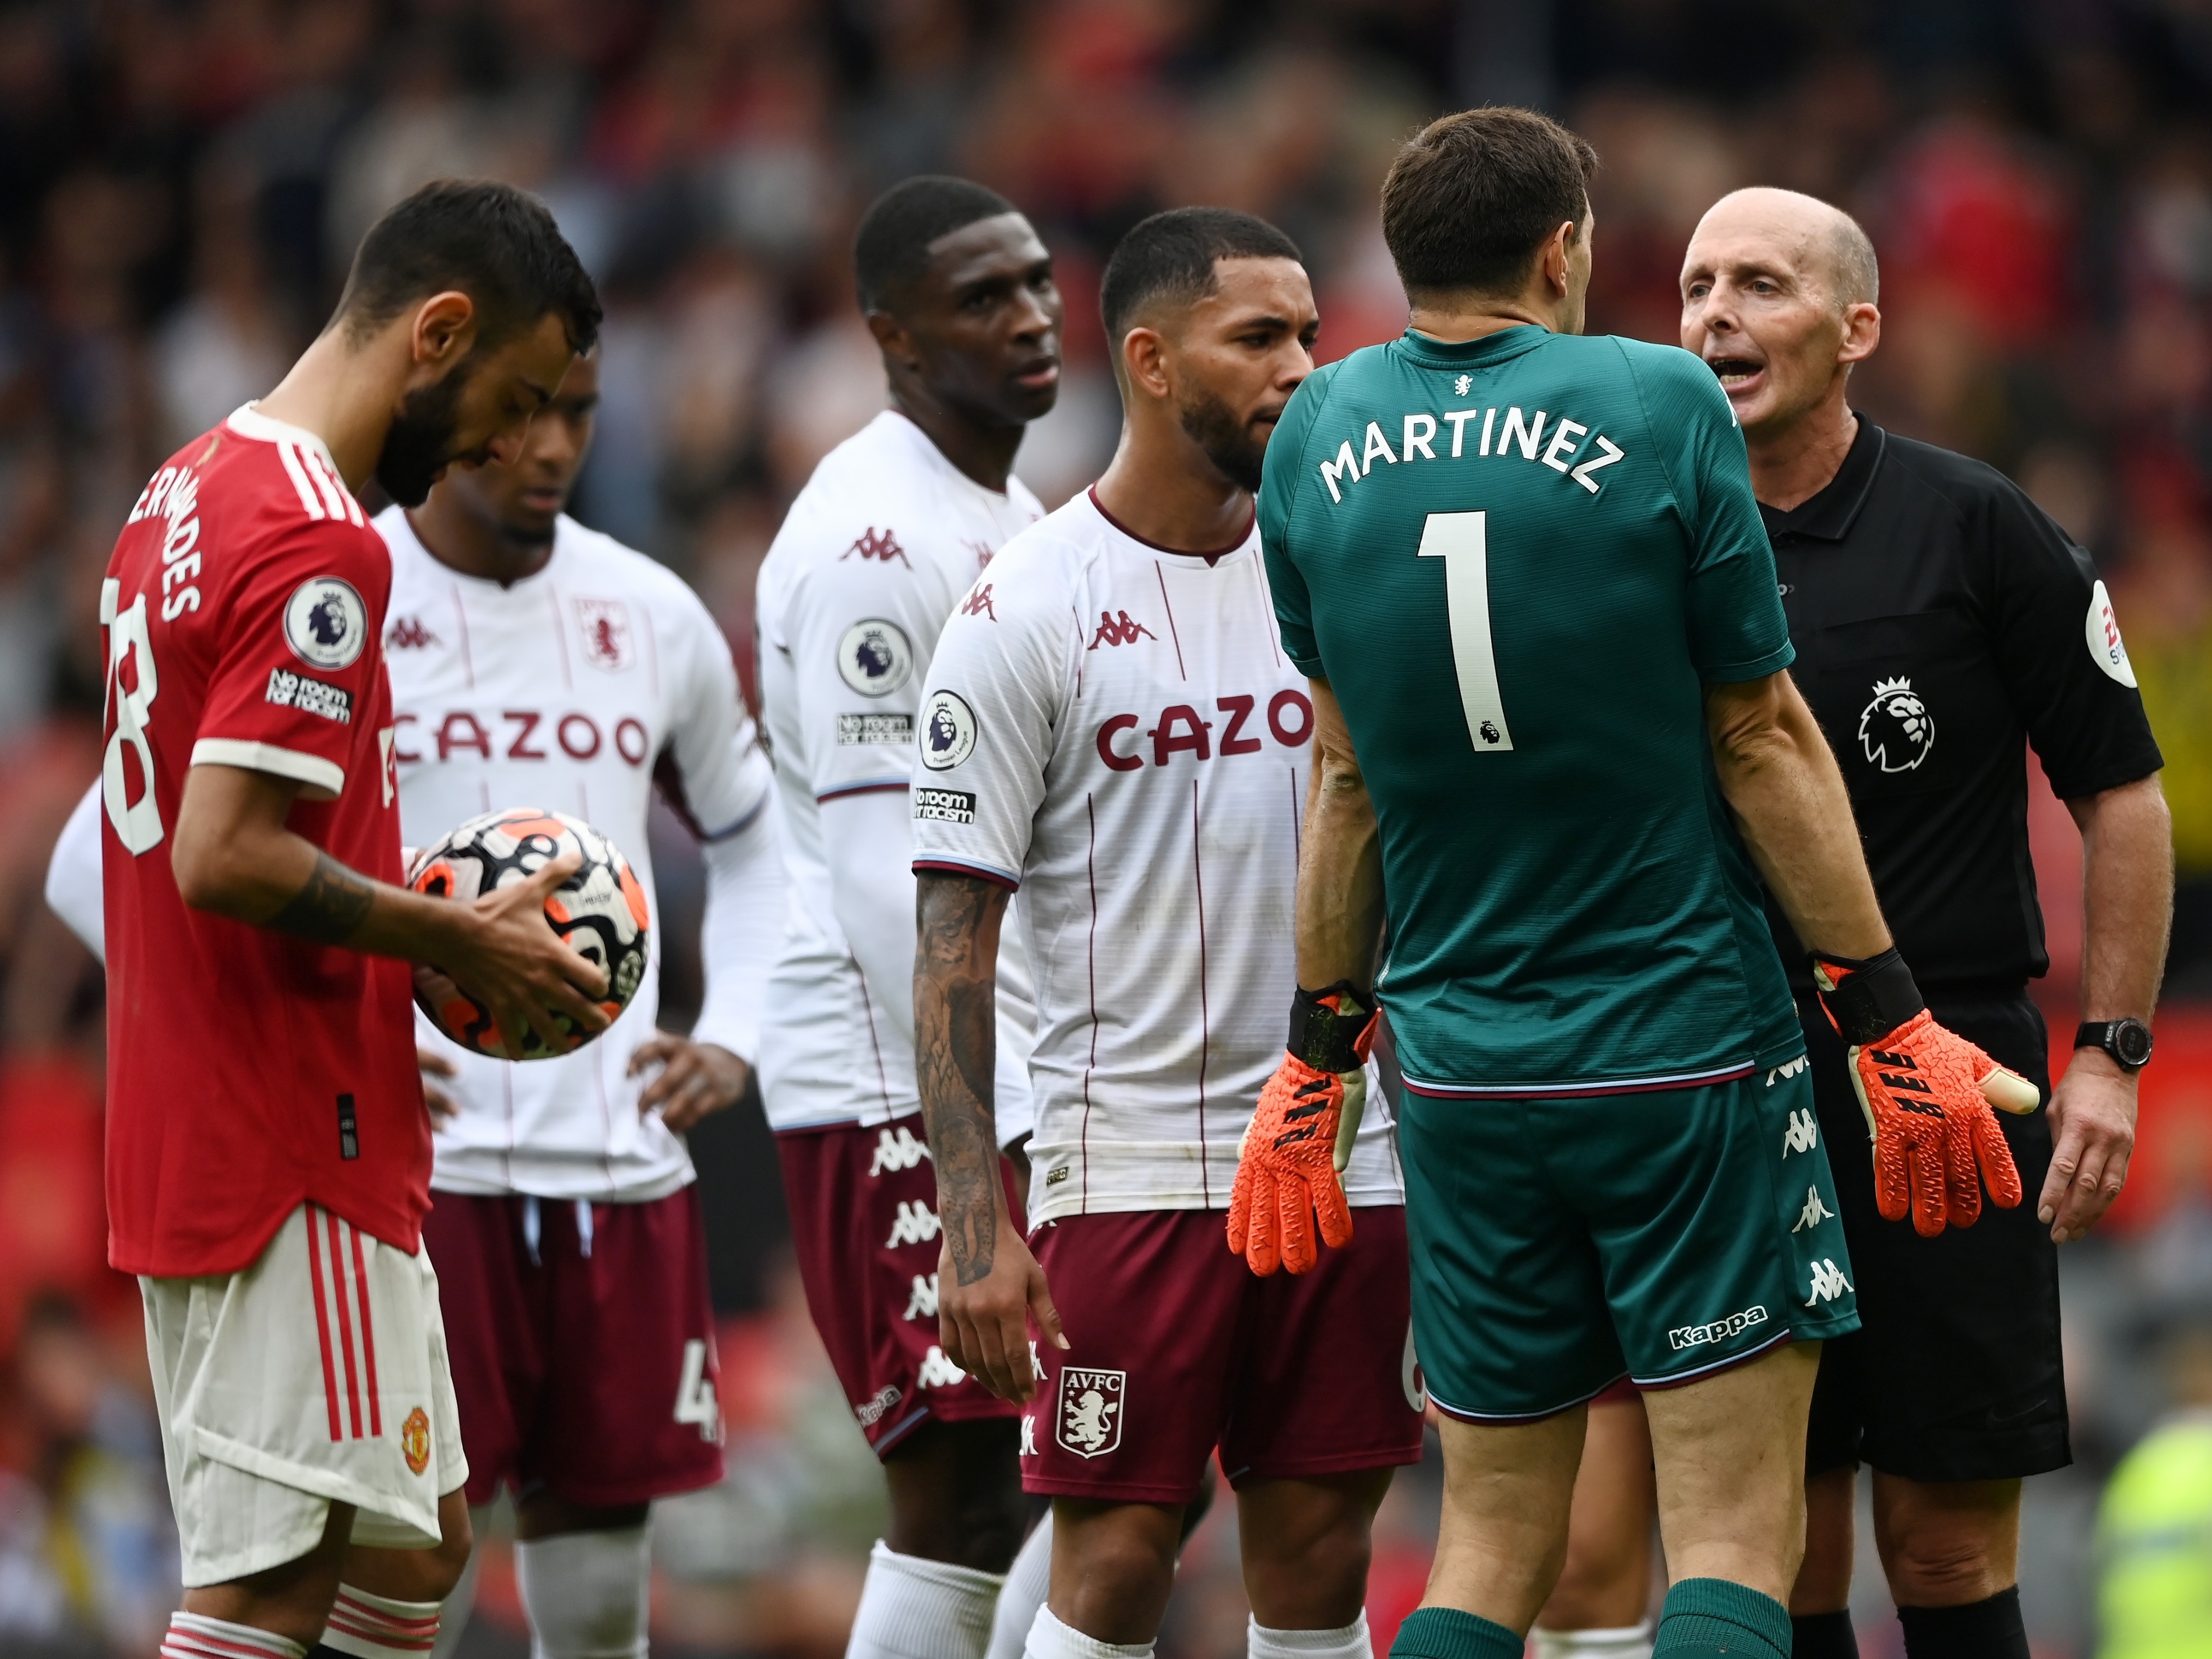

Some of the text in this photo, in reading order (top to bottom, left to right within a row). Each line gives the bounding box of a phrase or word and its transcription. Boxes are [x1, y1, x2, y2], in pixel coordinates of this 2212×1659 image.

[1319, 406, 1625, 505] MARTINEZ
[1417, 510, 1514, 752] 1
[270, 667, 348, 707] No room
[394, 712, 648, 768] CAZOO
[839, 716, 908, 732] No room
[1097, 689, 1315, 772] CAZO
[934, 731, 968, 764] Premier League
[923, 805, 974, 824] racism
[925, 791, 968, 809] room
[1669, 1305, 1768, 1350] Kappa
[673, 1339, 719, 1442] 4
[1065, 1372, 1120, 1392] AVFC
